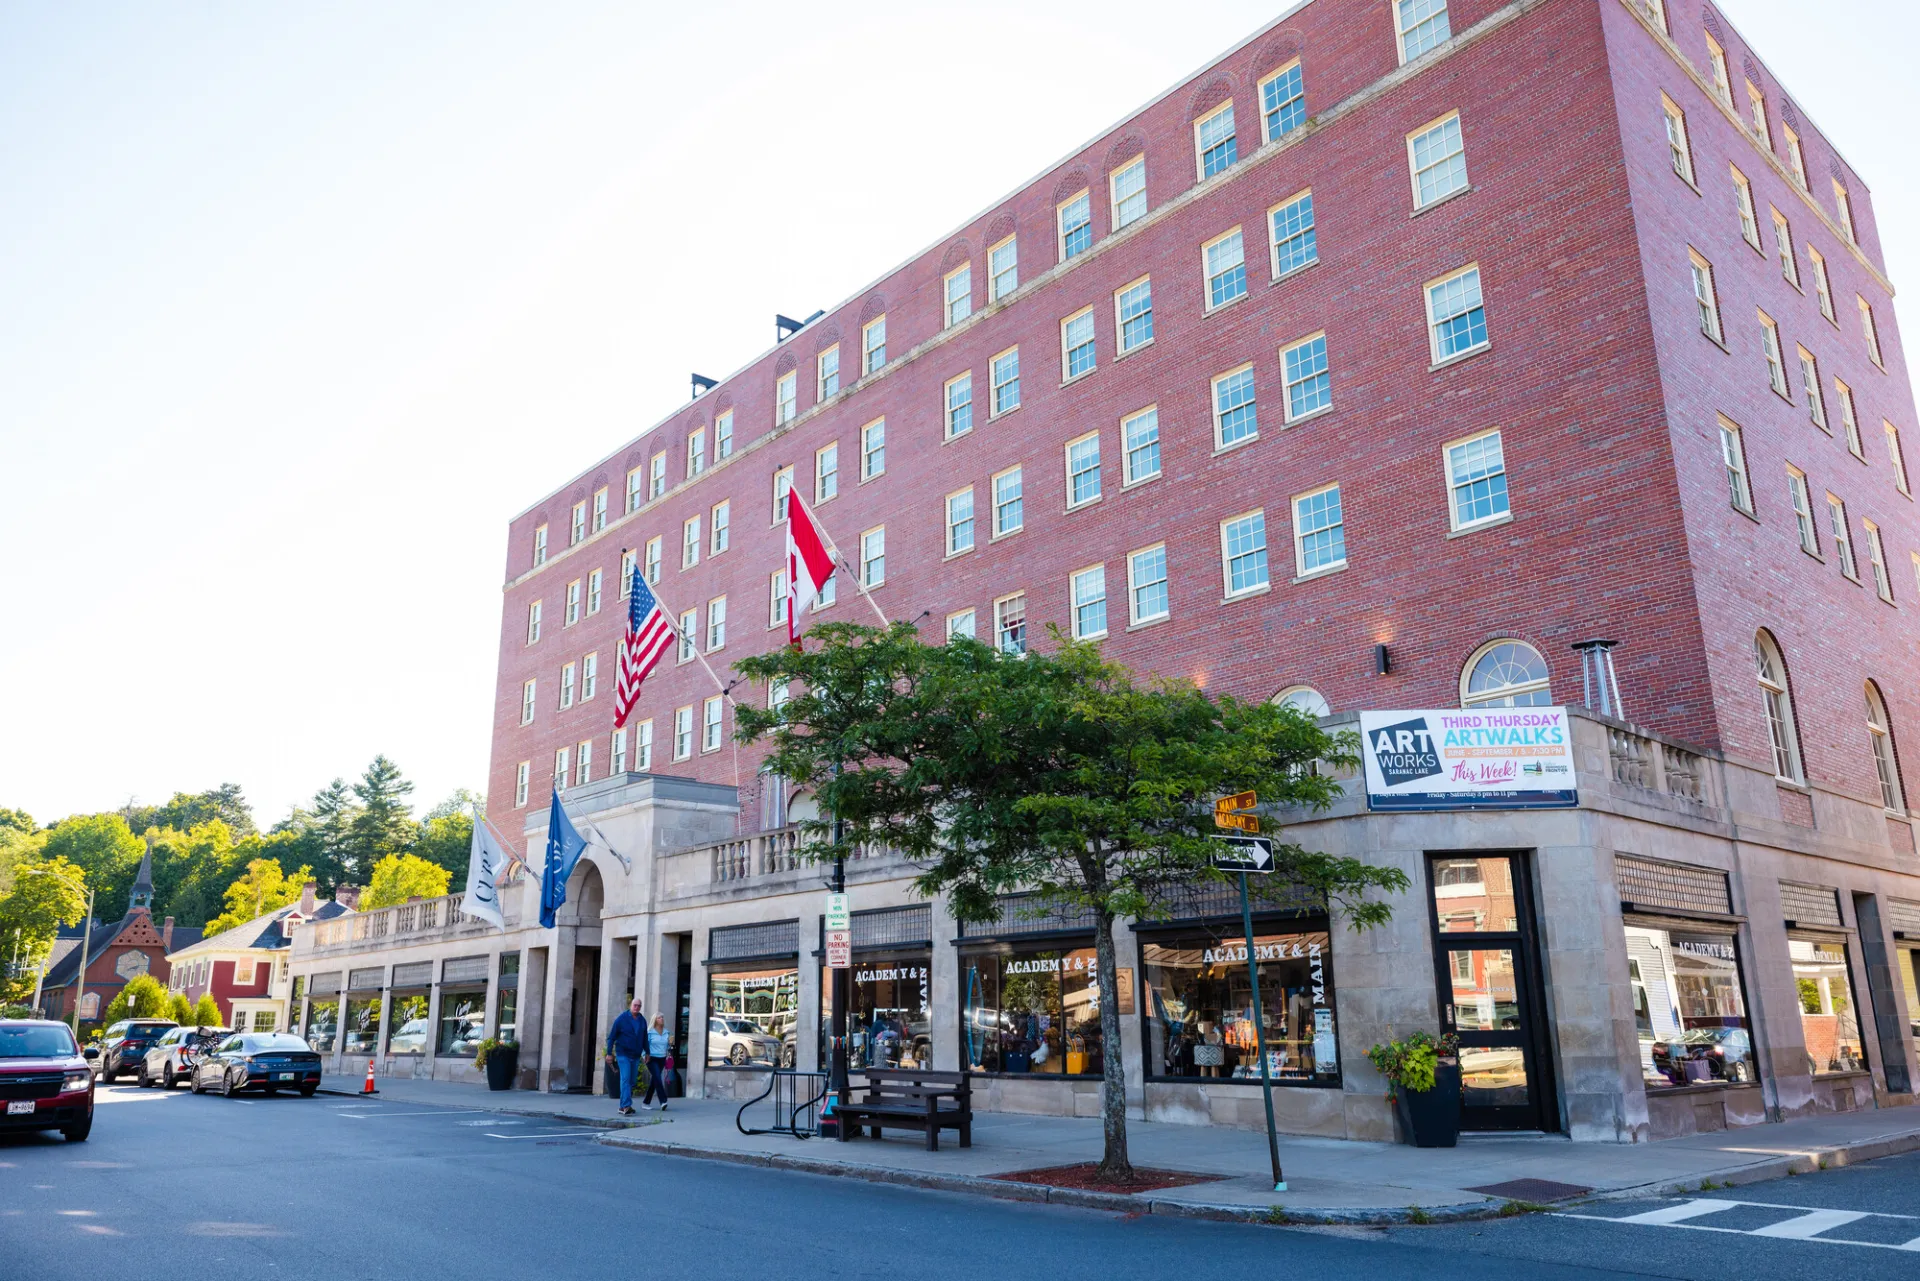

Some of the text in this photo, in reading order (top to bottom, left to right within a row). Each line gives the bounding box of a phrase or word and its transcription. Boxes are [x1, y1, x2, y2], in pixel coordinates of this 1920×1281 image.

[1441, 714, 1560, 728] THIRD THURSDAY
[1376, 730, 1430, 753] ART
[1444, 727, 1563, 746] ARTWALKS
[1379, 754, 1436, 767] WORKS
[1451, 760, 1517, 781] This Week!
[1219, 798, 1252, 812] MAIN ST
[1219, 813, 1246, 828] ACADEMY
[1203, 944, 1303, 963] ACADEMY &
[1679, 942, 1719, 957] ACADEMY
[1006, 957, 1083, 974] ACADEMY &
[1309, 943, 1325, 1004] MAIN
[739, 977, 779, 988] ACADEMY
[855, 968, 917, 982] ACADEMY &
[1088, 957, 1098, 1010] MAIN
[919, 967, 927, 1013] MAIN
